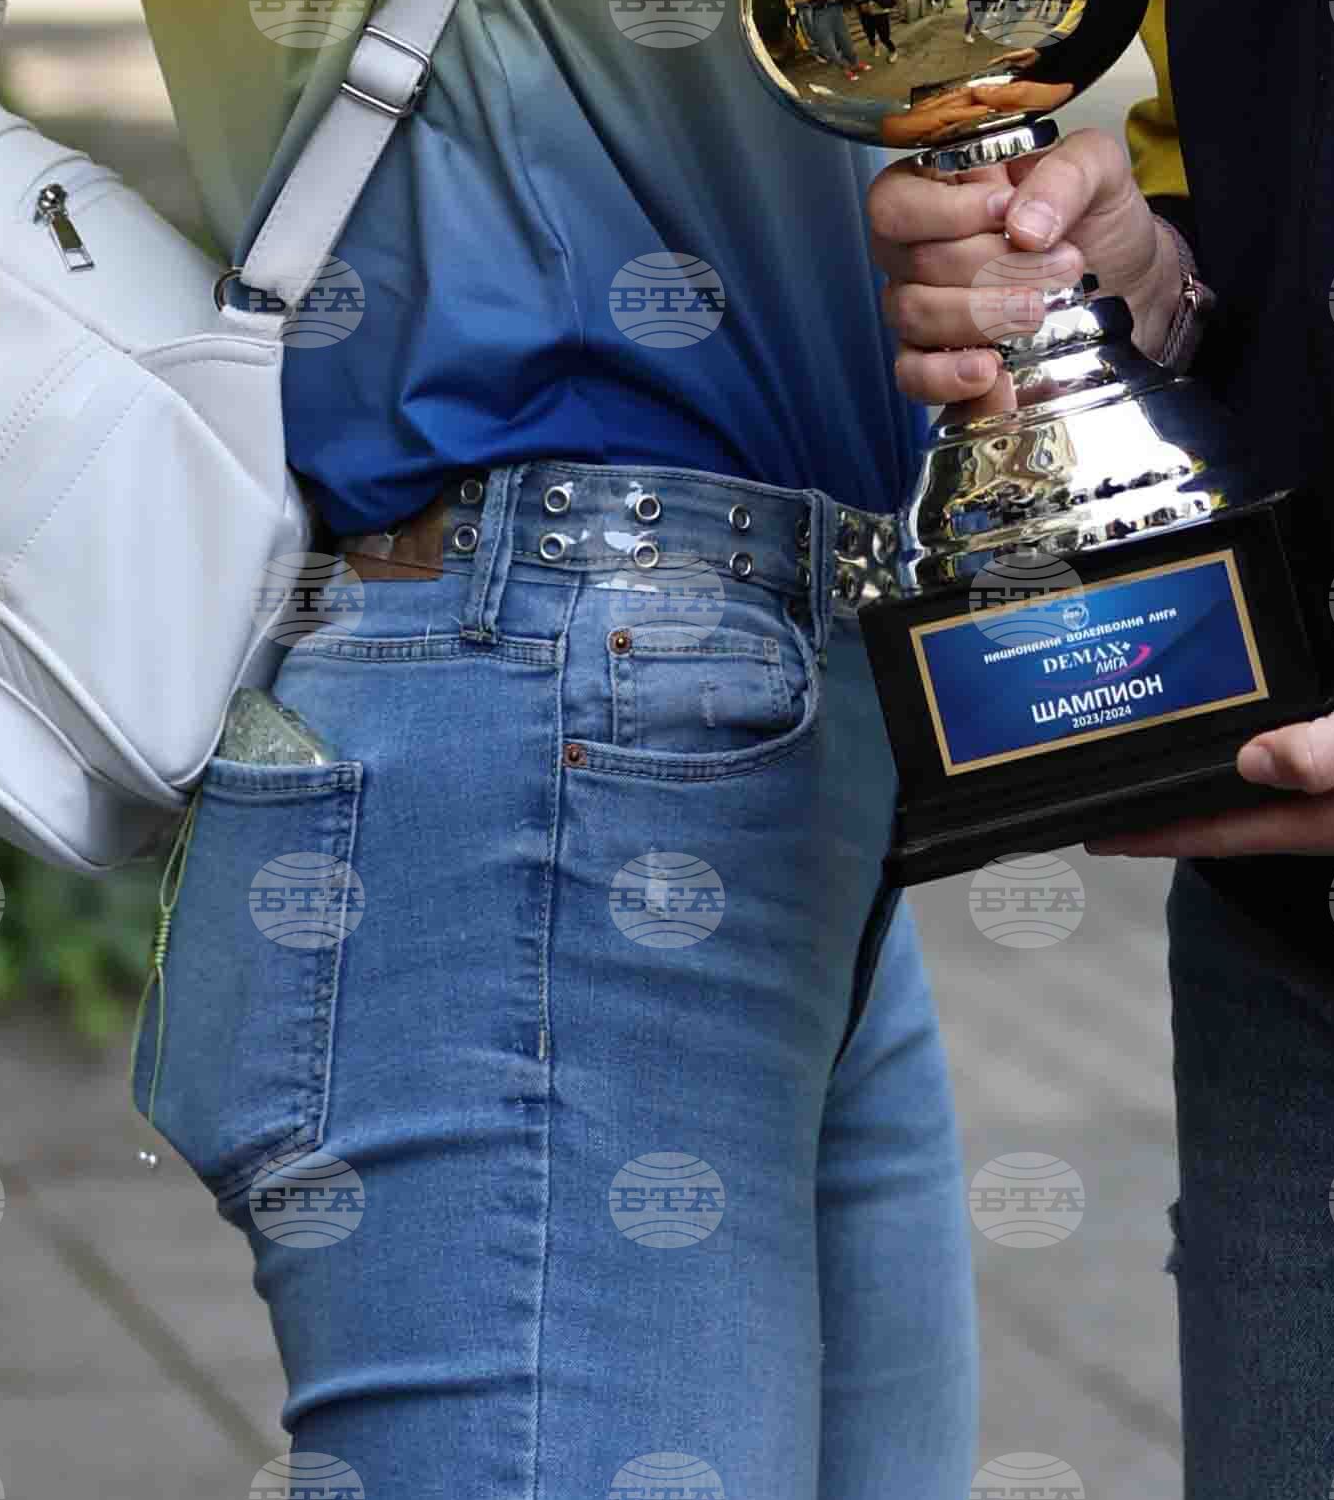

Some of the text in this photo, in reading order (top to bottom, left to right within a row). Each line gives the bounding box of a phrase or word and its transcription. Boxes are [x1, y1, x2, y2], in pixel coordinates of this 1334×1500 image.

[1095, 655, 1128, 675] ЛИГА
[1031, 673, 1164, 724] ШАМПИОН
[1071, 704, 1132, 729] 2023/2024
